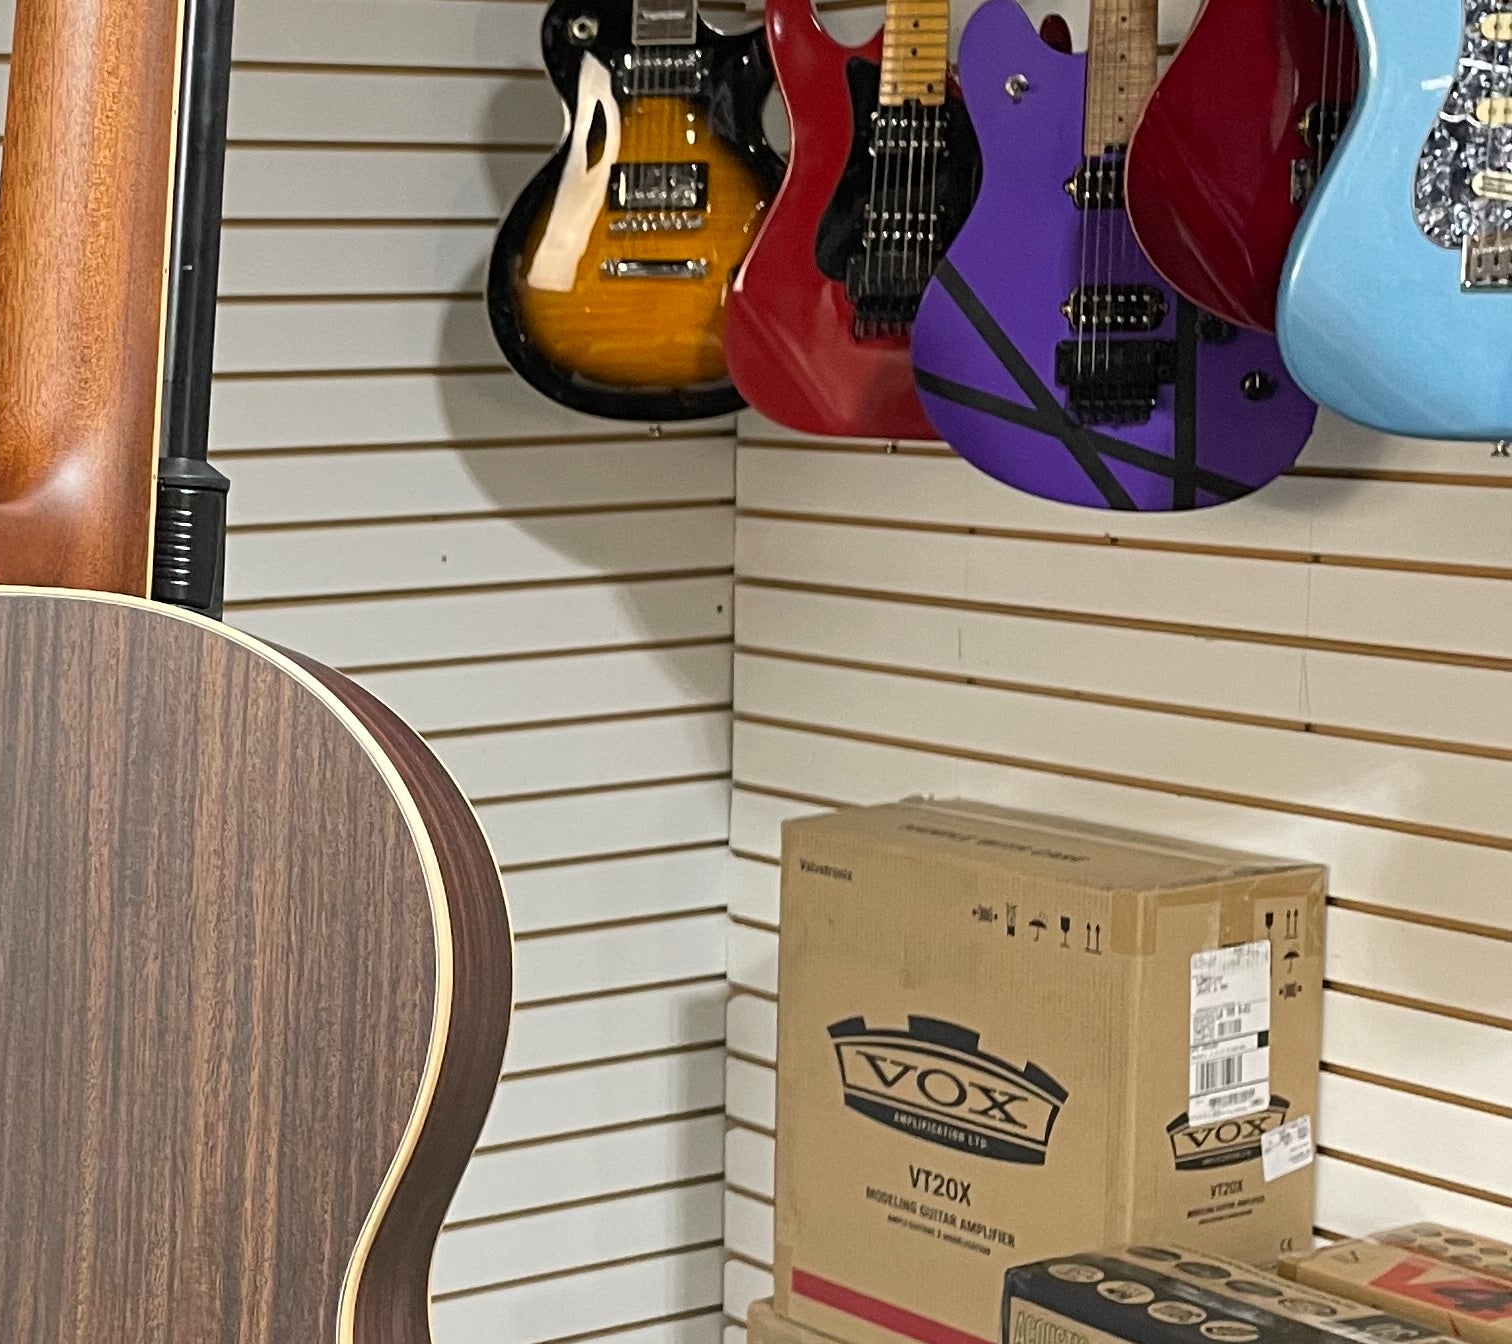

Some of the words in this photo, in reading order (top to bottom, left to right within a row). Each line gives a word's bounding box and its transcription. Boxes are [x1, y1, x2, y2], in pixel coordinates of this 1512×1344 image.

[855, 1049, 1029, 1130] VOX
[892, 1110, 966, 1143] AMPLIFICATION
[967, 1133, 989, 1150] LTD
[1183, 1115, 1272, 1149] VOX
[908, 1164, 972, 1207] VT20X
[865, 1185, 918, 1216] MODELING
[919, 1203, 958, 1229] GUITAR
[959, 1217, 1016, 1248] AMPLIFIER
